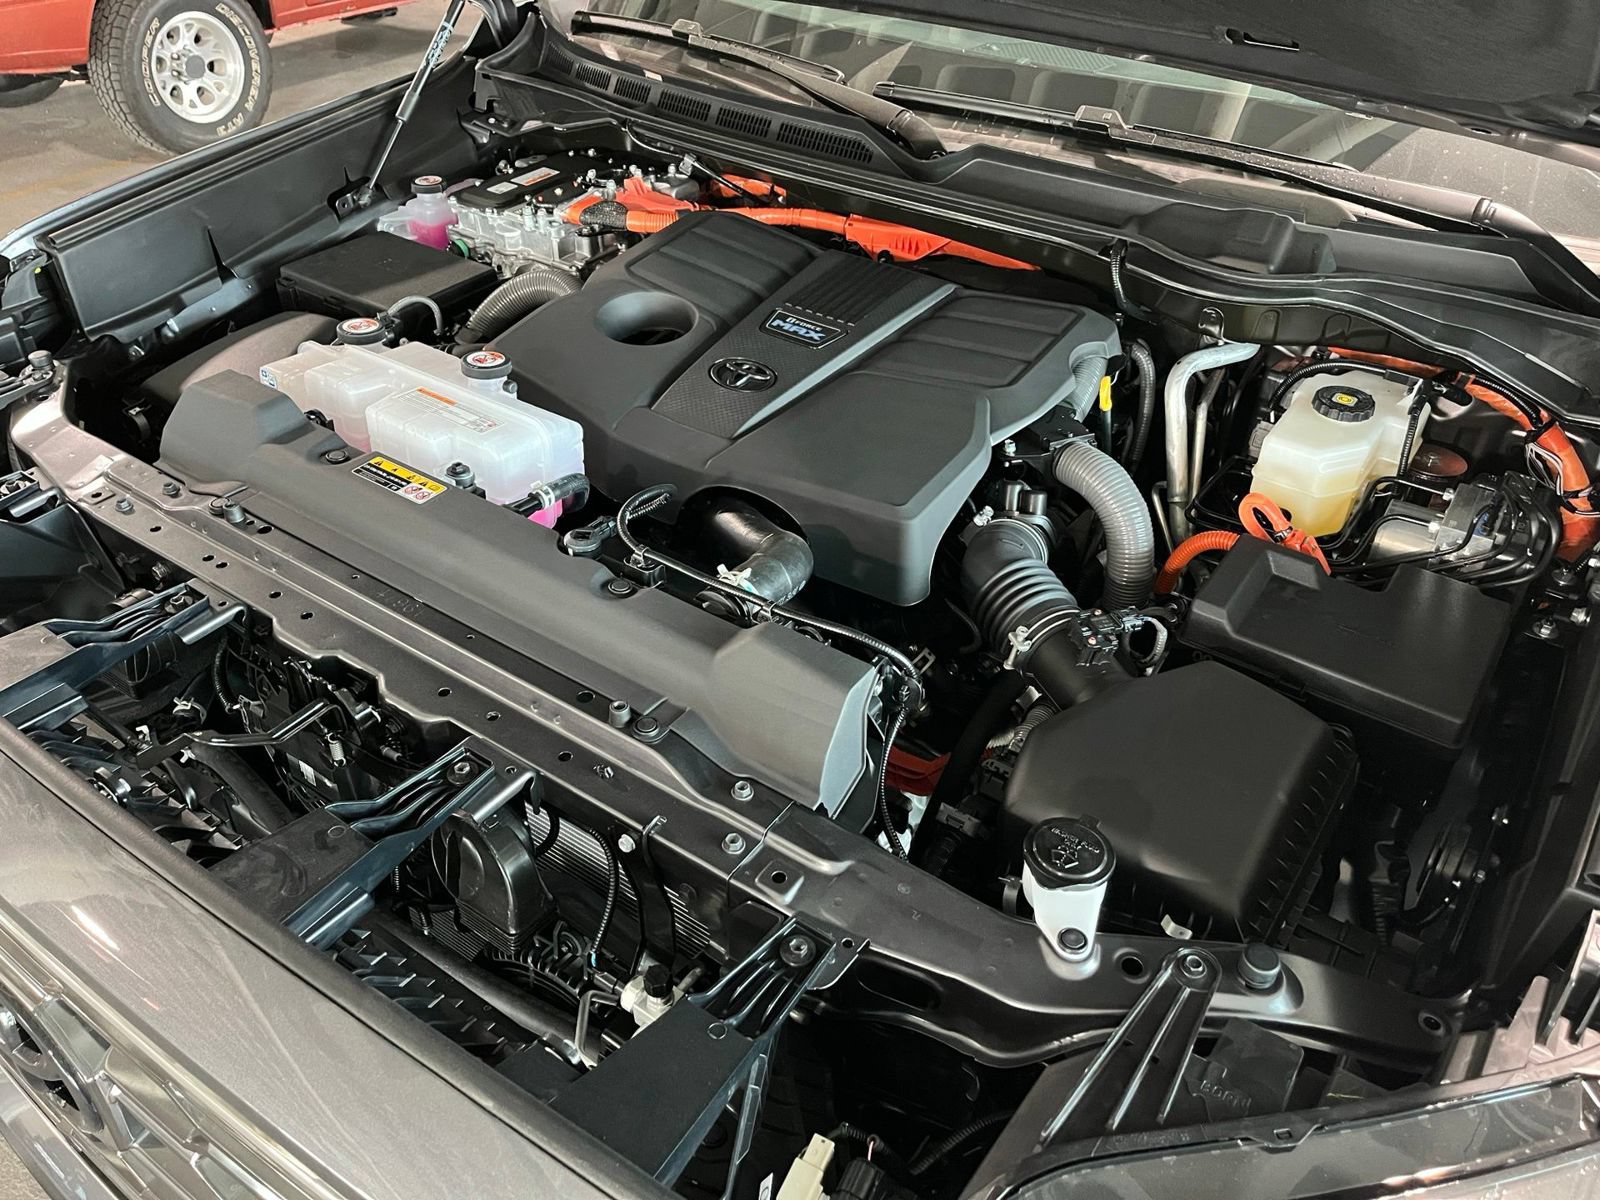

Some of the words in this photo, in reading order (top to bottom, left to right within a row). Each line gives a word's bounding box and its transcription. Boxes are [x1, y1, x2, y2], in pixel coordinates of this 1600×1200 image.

[141, 17, 161, 107] COOPER
[215, 3, 261, 112] DISCOVERER
[771, 318, 826, 341] MAX
